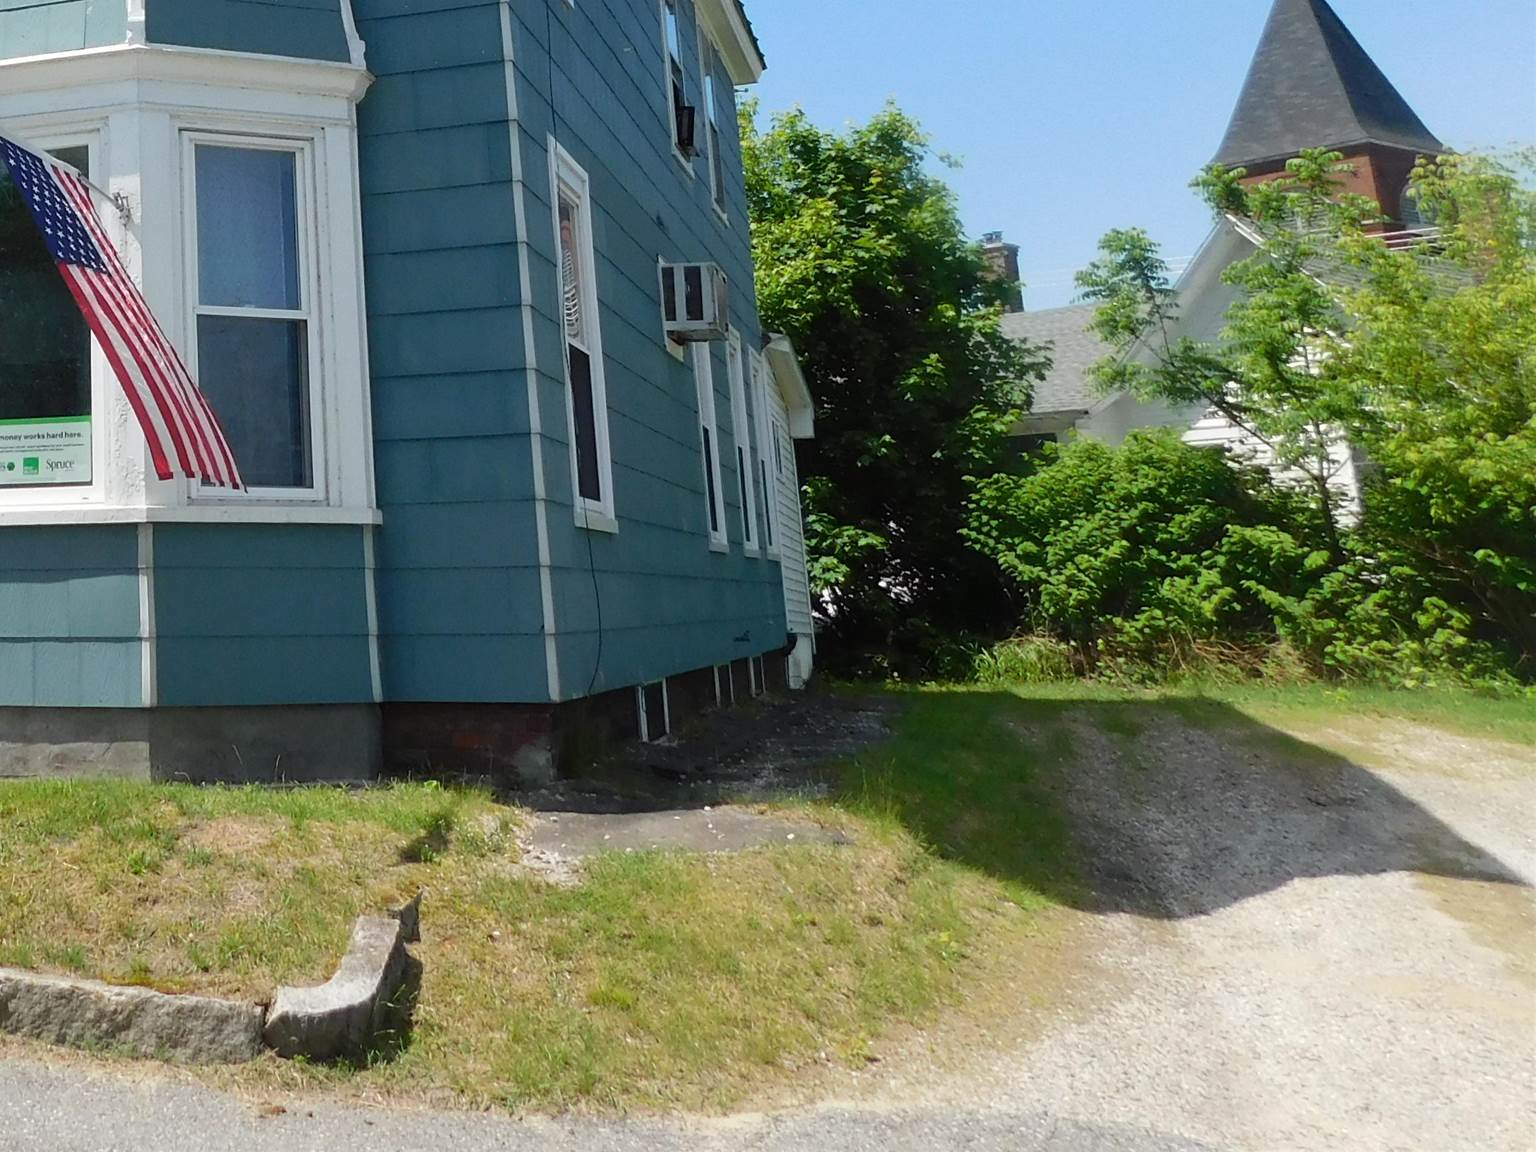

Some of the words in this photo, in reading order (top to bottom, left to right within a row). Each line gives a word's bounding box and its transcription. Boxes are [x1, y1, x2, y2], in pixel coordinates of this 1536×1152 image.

[23, 432, 45, 440] works
[46, 431, 64, 439] hard
[45, 458, 73, 472] Spruce
